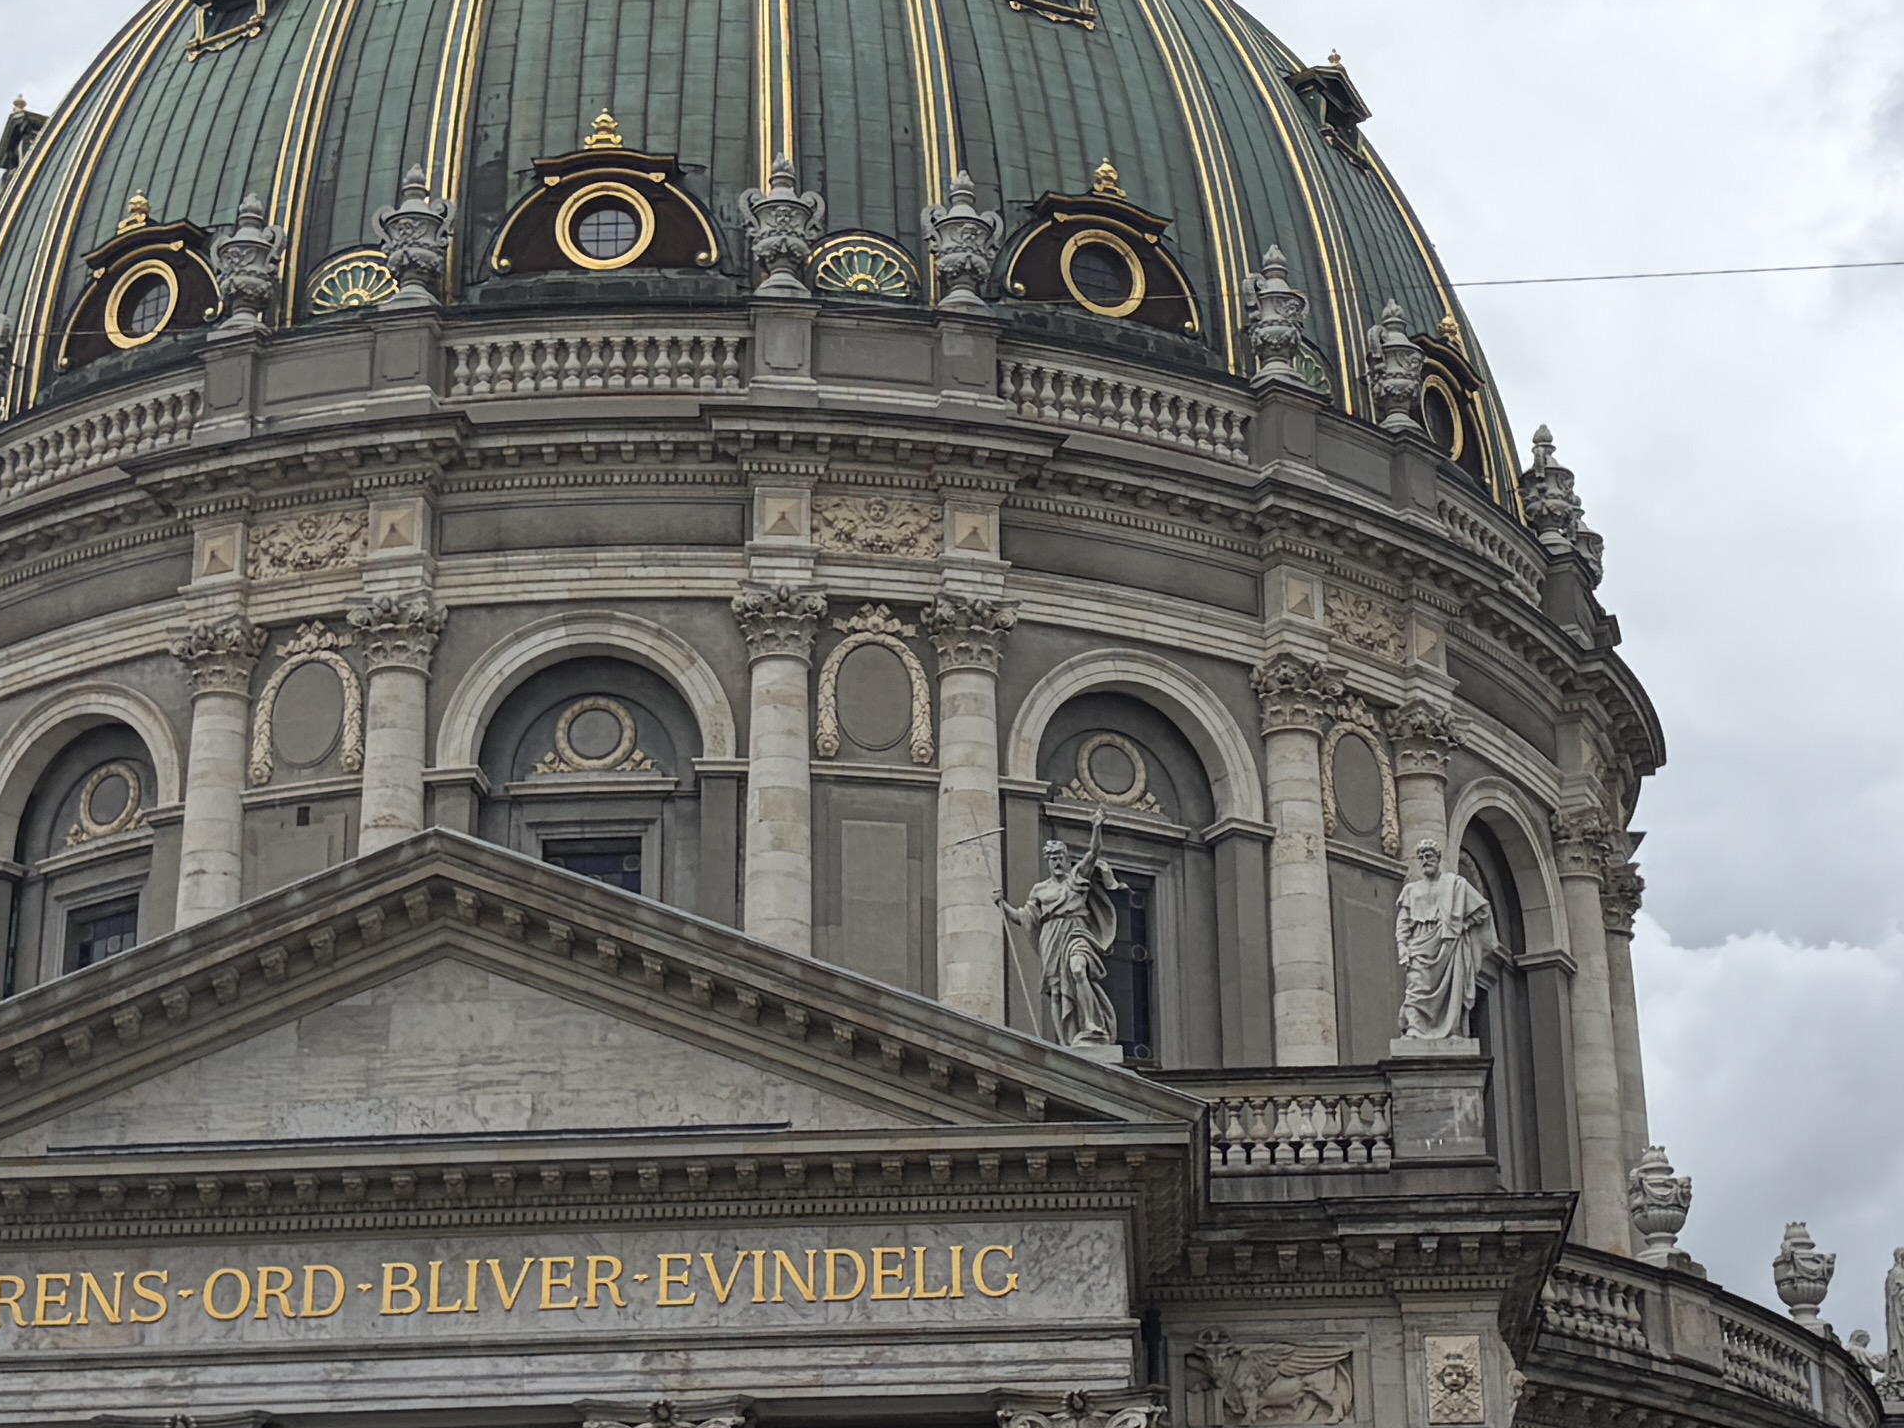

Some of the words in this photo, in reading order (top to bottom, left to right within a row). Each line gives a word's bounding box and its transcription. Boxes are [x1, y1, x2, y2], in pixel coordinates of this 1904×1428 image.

[203, 1265, 346, 1321] ORD
[382, 1255, 625, 1315] BLIVER
[657, 1246, 1018, 1307] EVINDELIG
